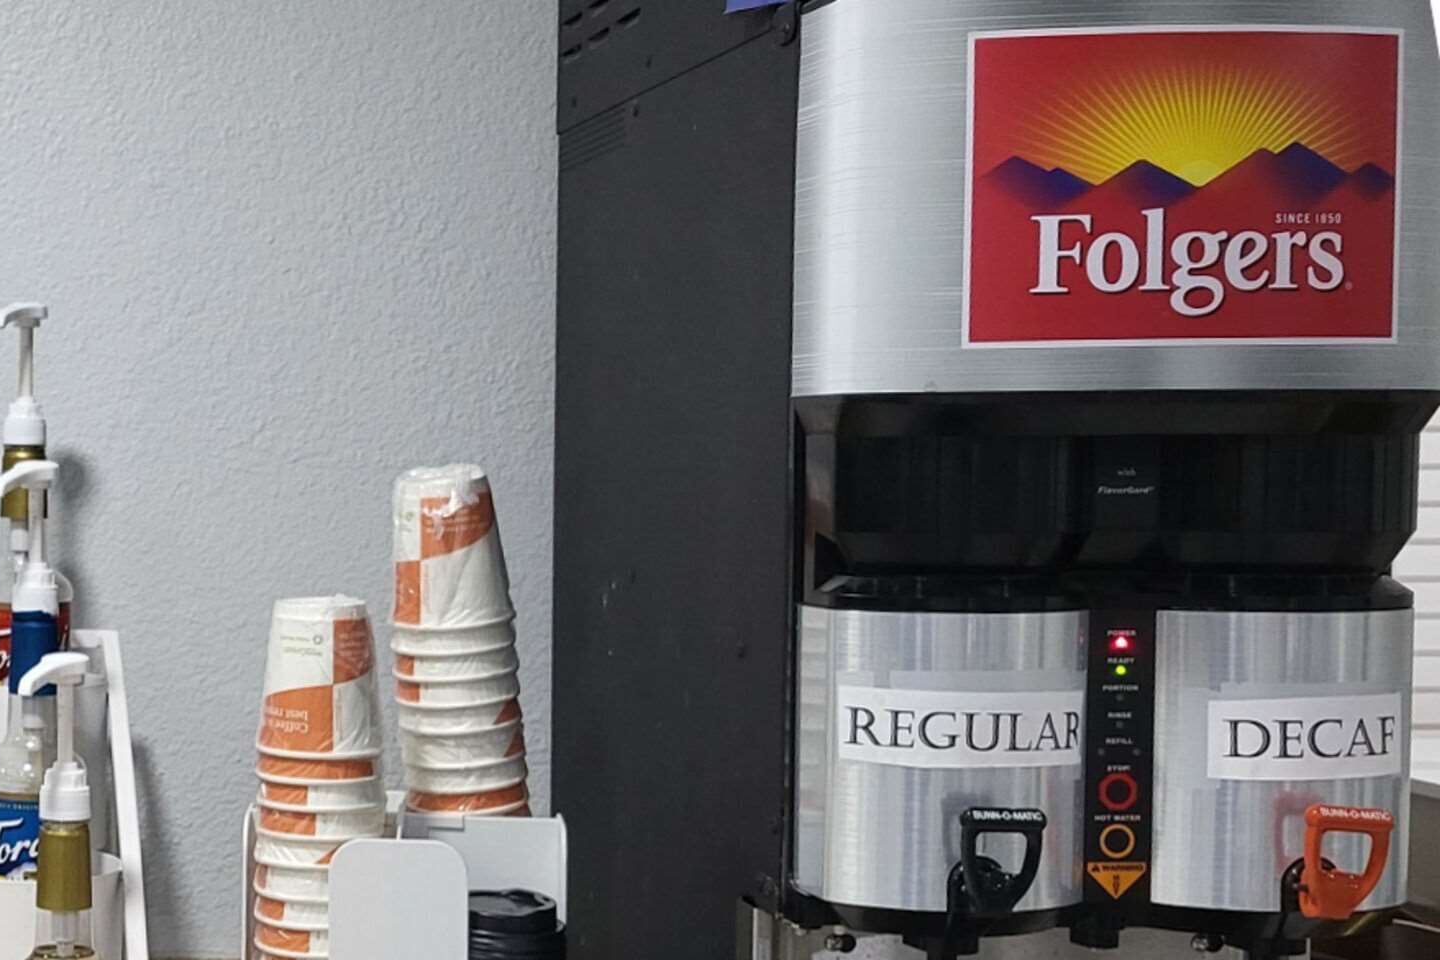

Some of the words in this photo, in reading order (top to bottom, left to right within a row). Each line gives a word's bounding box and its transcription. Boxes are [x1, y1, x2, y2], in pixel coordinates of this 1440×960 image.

[1275, 212, 1310, 224] SINCE
[1028, 208, 1345, 317] Folgers
[844, 705, 1080, 751] REGULAR
[1221, 716, 1396, 759] DECAF
